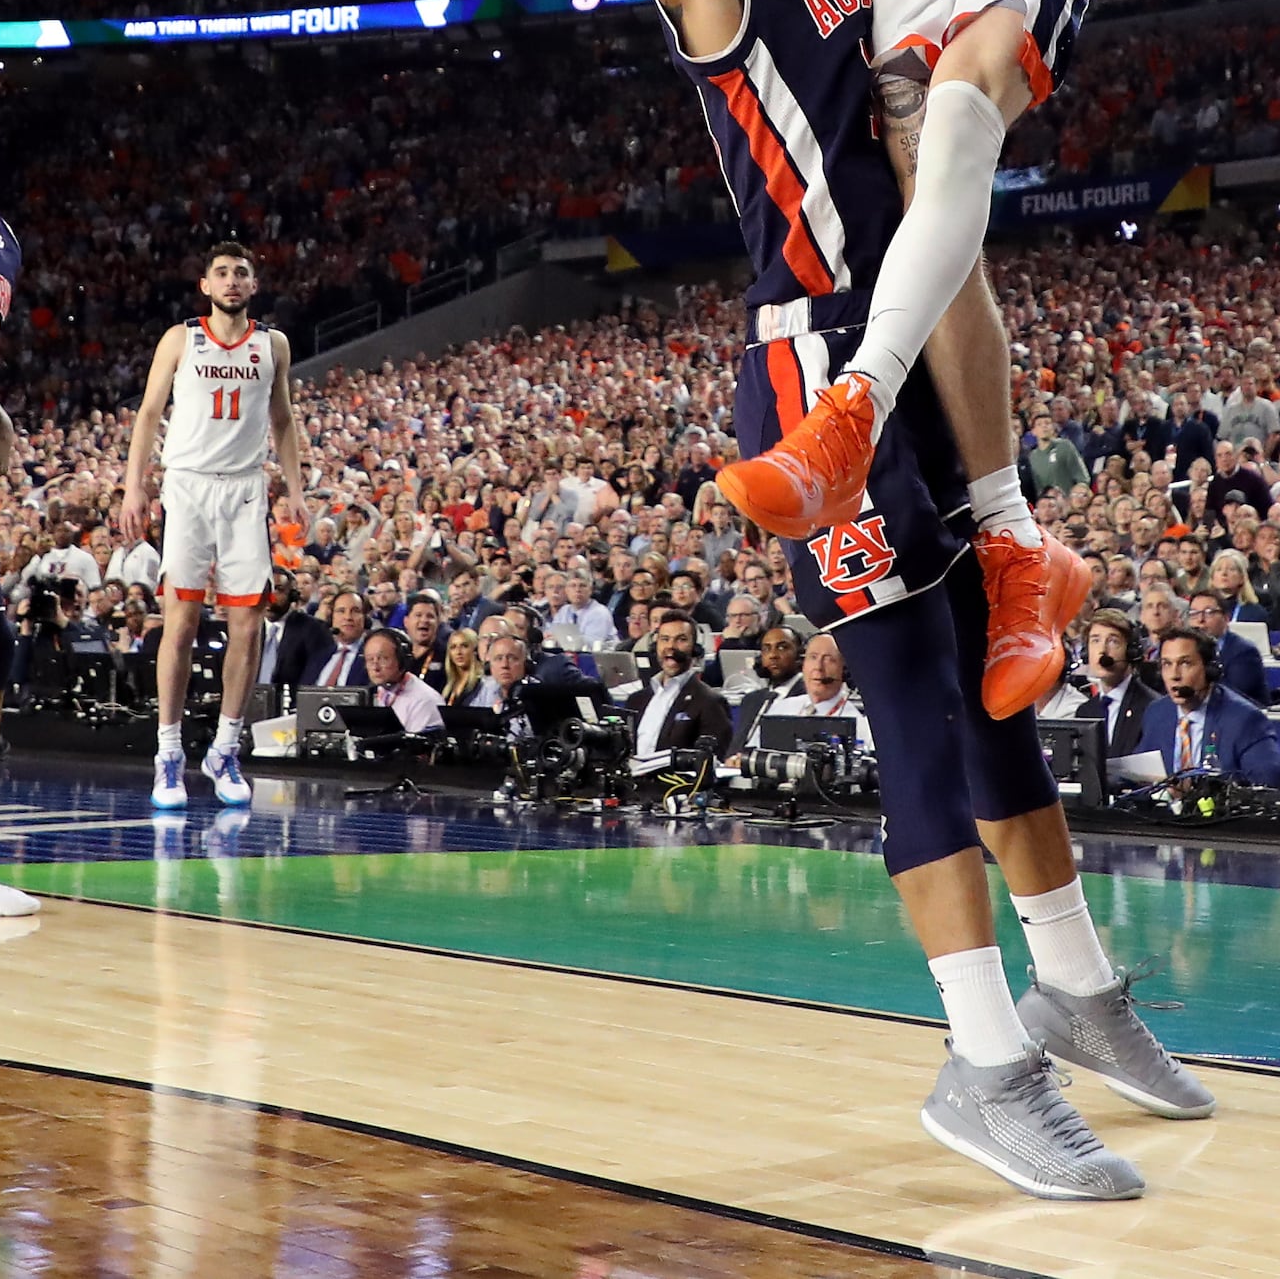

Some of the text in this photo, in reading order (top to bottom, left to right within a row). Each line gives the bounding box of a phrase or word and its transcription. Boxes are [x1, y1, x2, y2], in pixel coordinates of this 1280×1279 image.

[124, 21, 156, 37] AND
[157, 20, 196, 35] THEN
[291, 5, 360, 35] FOUR
[1021, 189, 1080, 216] FINAL
[195, 365, 260, 380] VIRGINIA
[210, 386, 241, 420] 11
